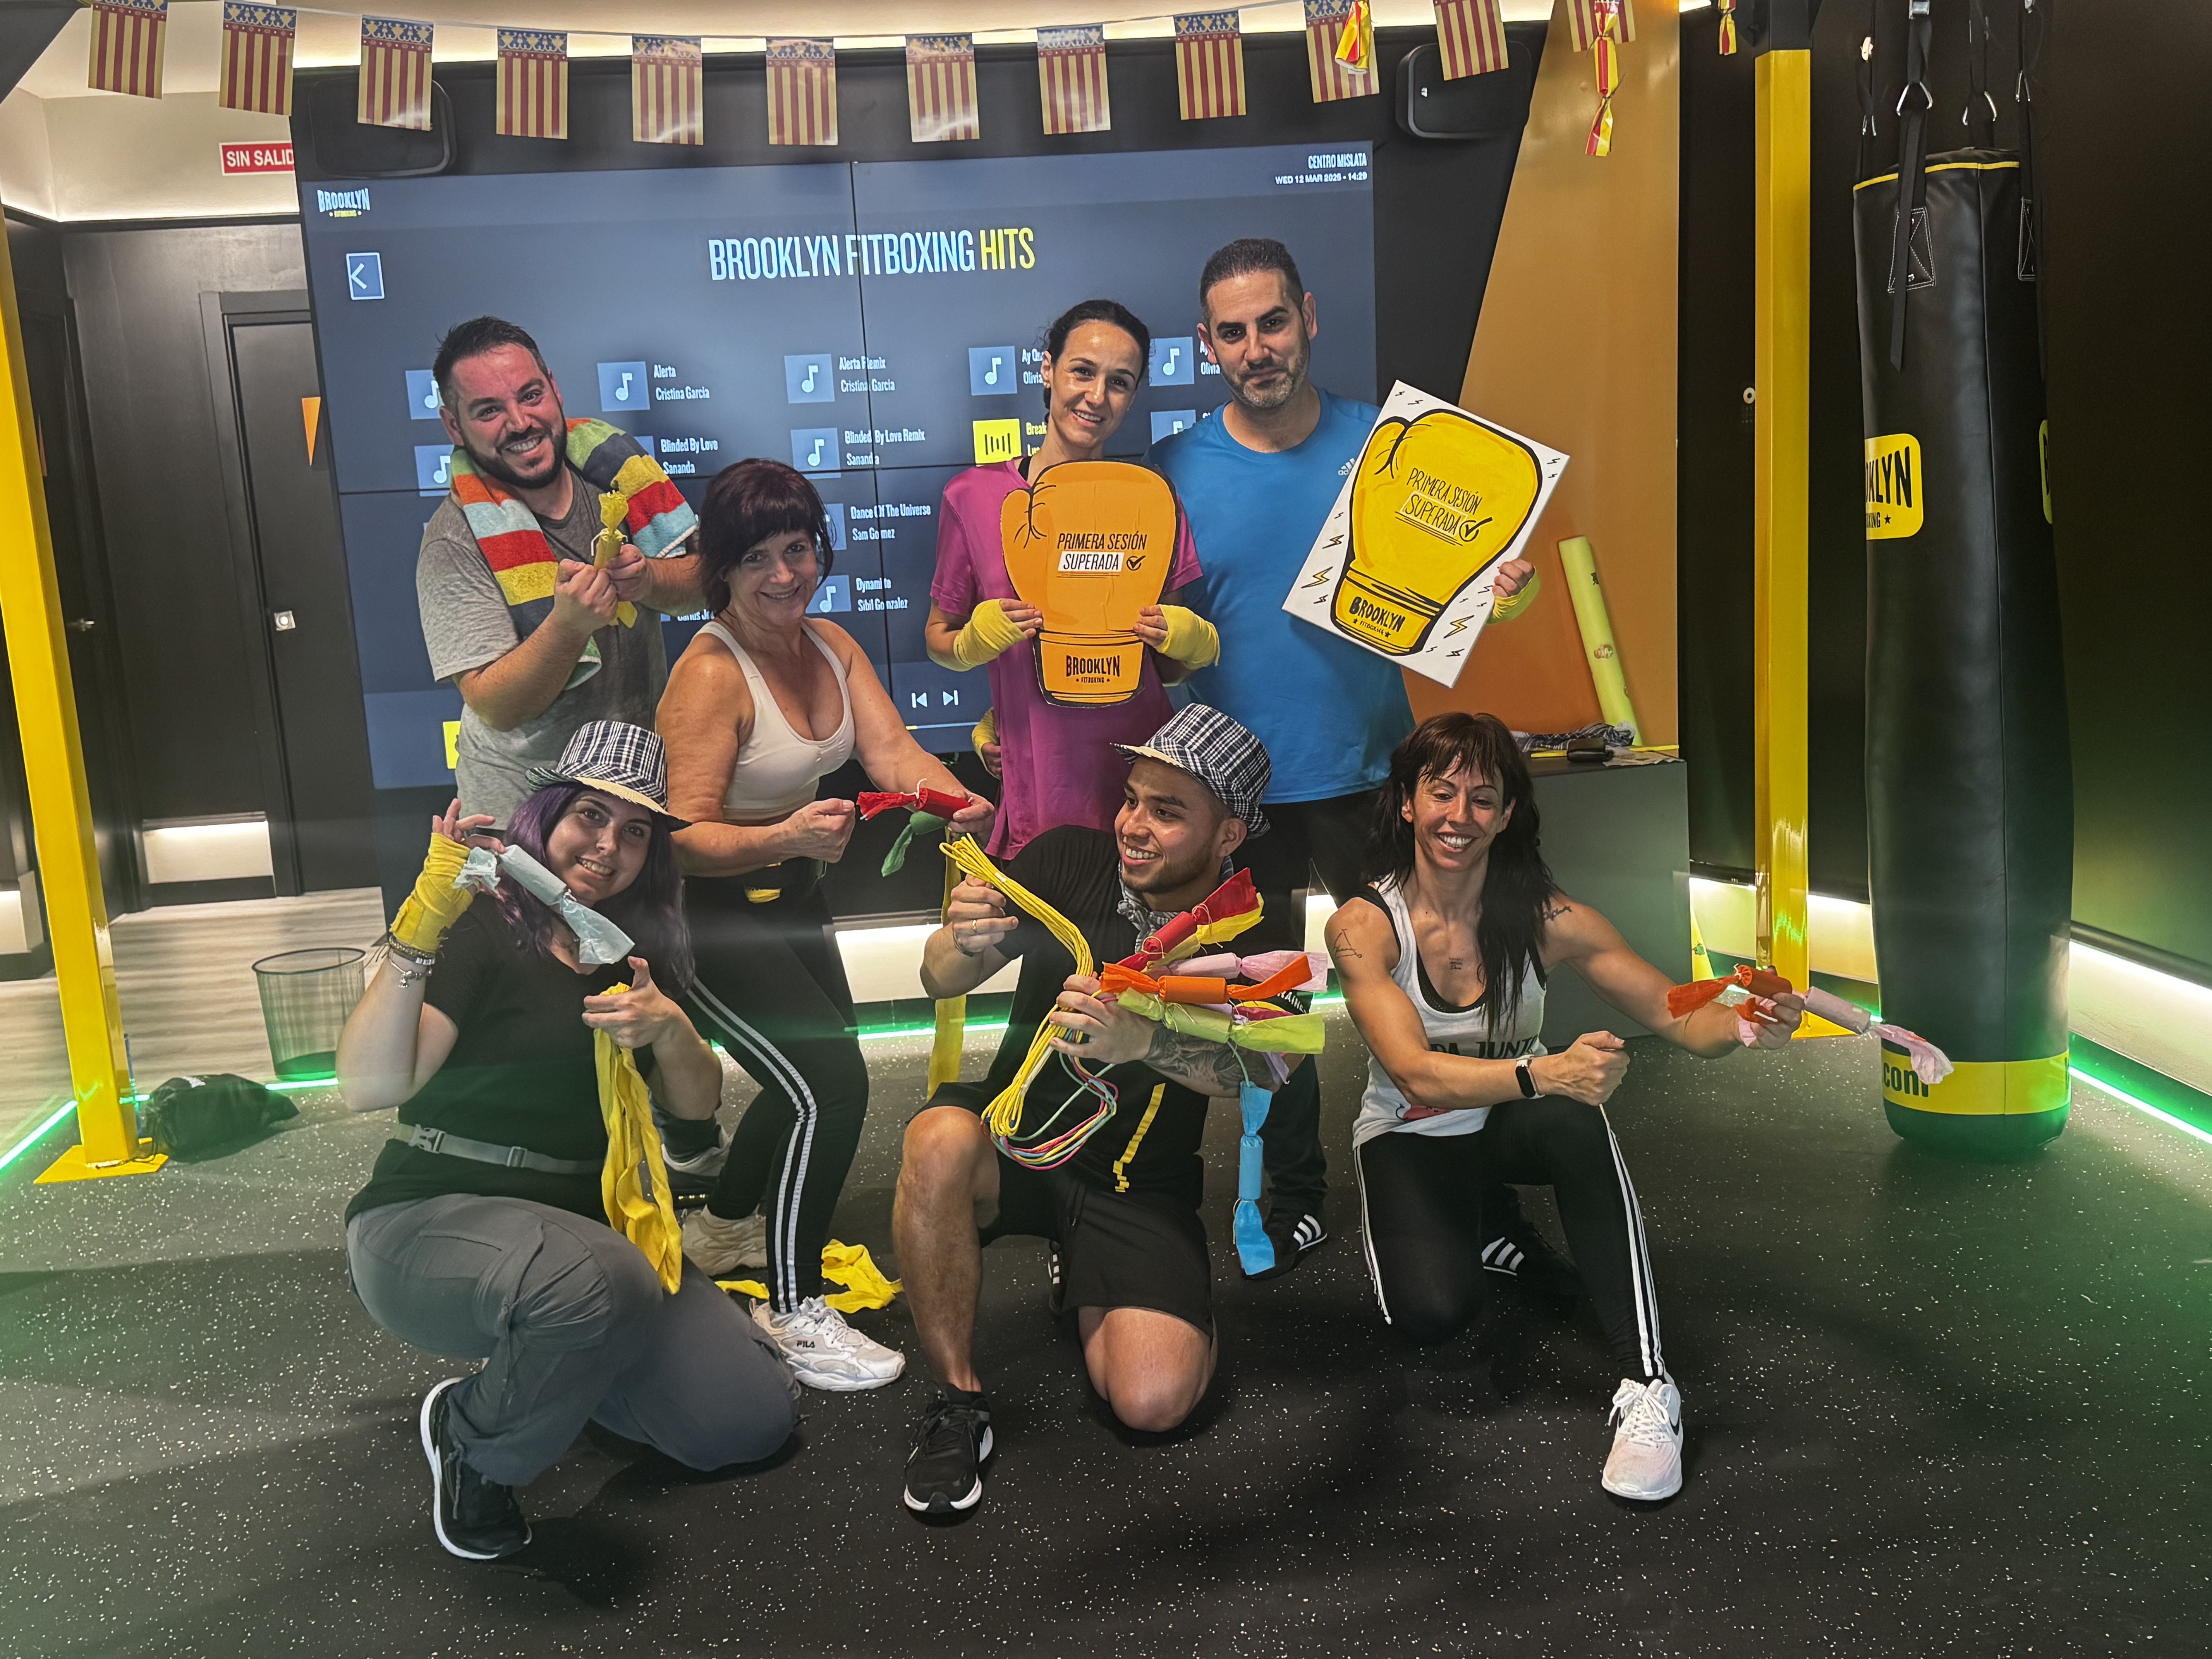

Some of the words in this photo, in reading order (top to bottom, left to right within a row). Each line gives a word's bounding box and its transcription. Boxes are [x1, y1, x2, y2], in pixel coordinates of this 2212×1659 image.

[227, 151, 250, 167] SIN
[1308, 155, 1336, 169] CENTRO
[1337, 153, 1367, 167] MISLATA
[1275, 176, 1293, 184] WED
[1295, 175, 1304, 184] 12
[1305, 174, 1322, 183] MAR
[317, 188, 371, 213] BROOKLYN
[709, 235, 840, 280] BROOKLYN
[844, 230, 975, 275] FITBOXING
[980, 227, 1036, 270] HITS
[839, 357, 861, 370] Alerta
[1022, 349, 1031, 365] Ay
[654, 364, 676, 378] Alerta
[1023, 371, 1043, 384] Olivia
[656, 387, 685, 401] Cristina
[841, 379, 871, 393] Cristina
[845, 429, 872, 444] Blinded
[874, 429, 884, 445] By
[885, 429, 902, 443] Love
[903, 429, 926, 442] Remix
[661, 438, 689, 453] Blinded
[689, 438, 700, 454] By
[700, 438, 718, 451] Love
[847, 452, 879, 466] Sananda
[663, 461, 695, 474] Sananda
[1406, 467, 1451, 502] PRIMERA
[1448, 486, 1483, 515] SESIÓN
[850, 505, 873, 519] Dance
[885, 504, 899, 517] The
[900, 503, 931, 517] Universe
[1405, 494, 1463, 535] SUPERADA
[852, 527, 869, 541] Sam
[869, 527, 895, 540] Gomez
[1057, 533, 1104, 550] PRIMERA
[1107, 530, 1147, 550] SESIÓN
[1063, 554, 1118, 570] SUPERADA
[856, 577, 891, 592] Dynamite
[875, 597, 908, 610] Gonzalez
[1349, 596, 1406, 632] BROOKLYN
[1066, 655, 1120, 677] BROOKLYN
